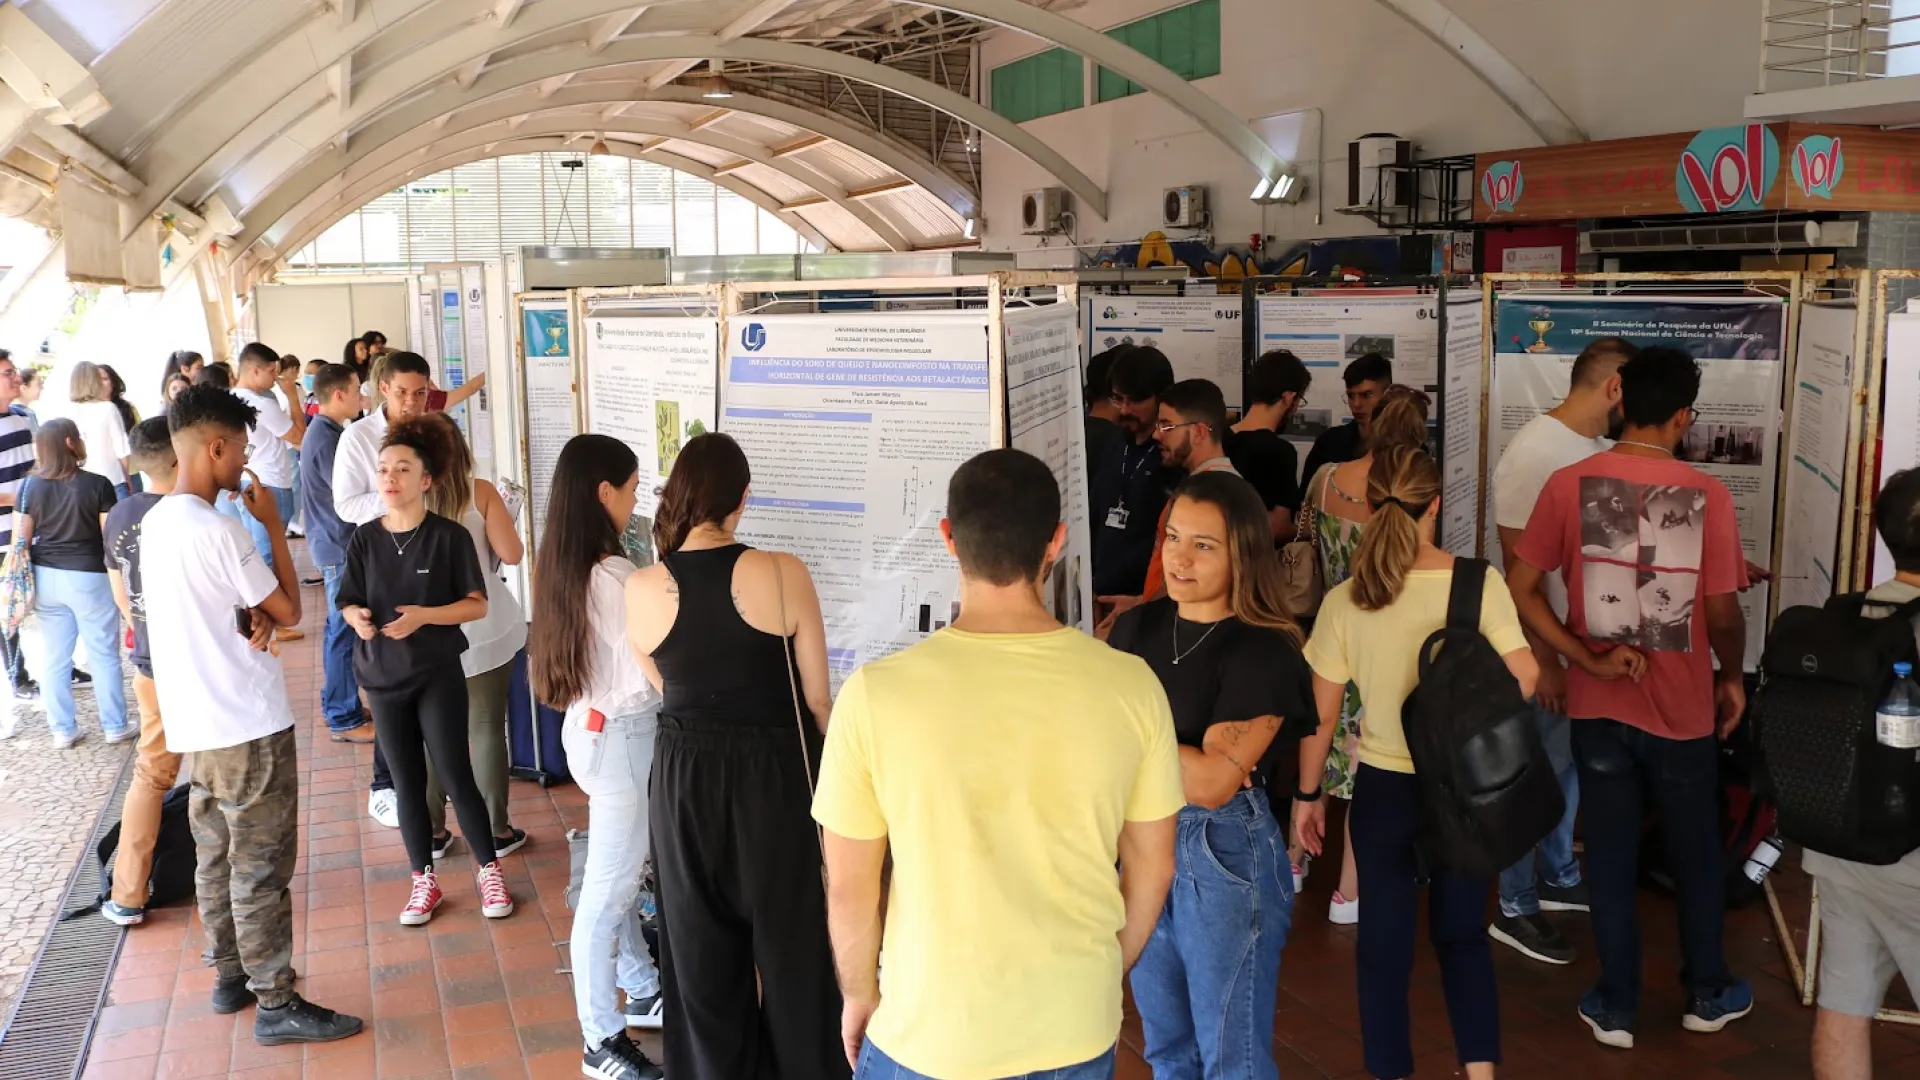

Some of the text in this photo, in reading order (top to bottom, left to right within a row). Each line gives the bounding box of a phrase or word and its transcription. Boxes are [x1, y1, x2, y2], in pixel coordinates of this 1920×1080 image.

[1600, 319, 1644, 328] Seminário
[1658, 321, 1697, 330] Pesquisa
[1620, 329, 1660, 337] Nacional
[1661, 330, 1673, 338] de
[1674, 330, 1706, 338] Ciência
[1714, 331, 1764, 341] Tecnologia
[748, 357, 790, 367] INFLUÊNCIA
[791, 359, 804, 367] DO
[804, 359, 825, 368] SORO
[826, 360, 836, 369] DE
[836, 360, 865, 370] QUEIJO
[866, 361, 871, 369] E
[871, 360, 937, 371] NANOCOMPOSTO
[938, 362, 951, 371] NA
[768, 371, 814, 380] HORIZONTAL
[815, 372, 825, 381] DE
[826, 373, 845, 381] GENE
[847, 373, 857, 382] DE
[858, 372, 904, 383] RESISTÊNCIA
[905, 374, 921, 383] AOS
